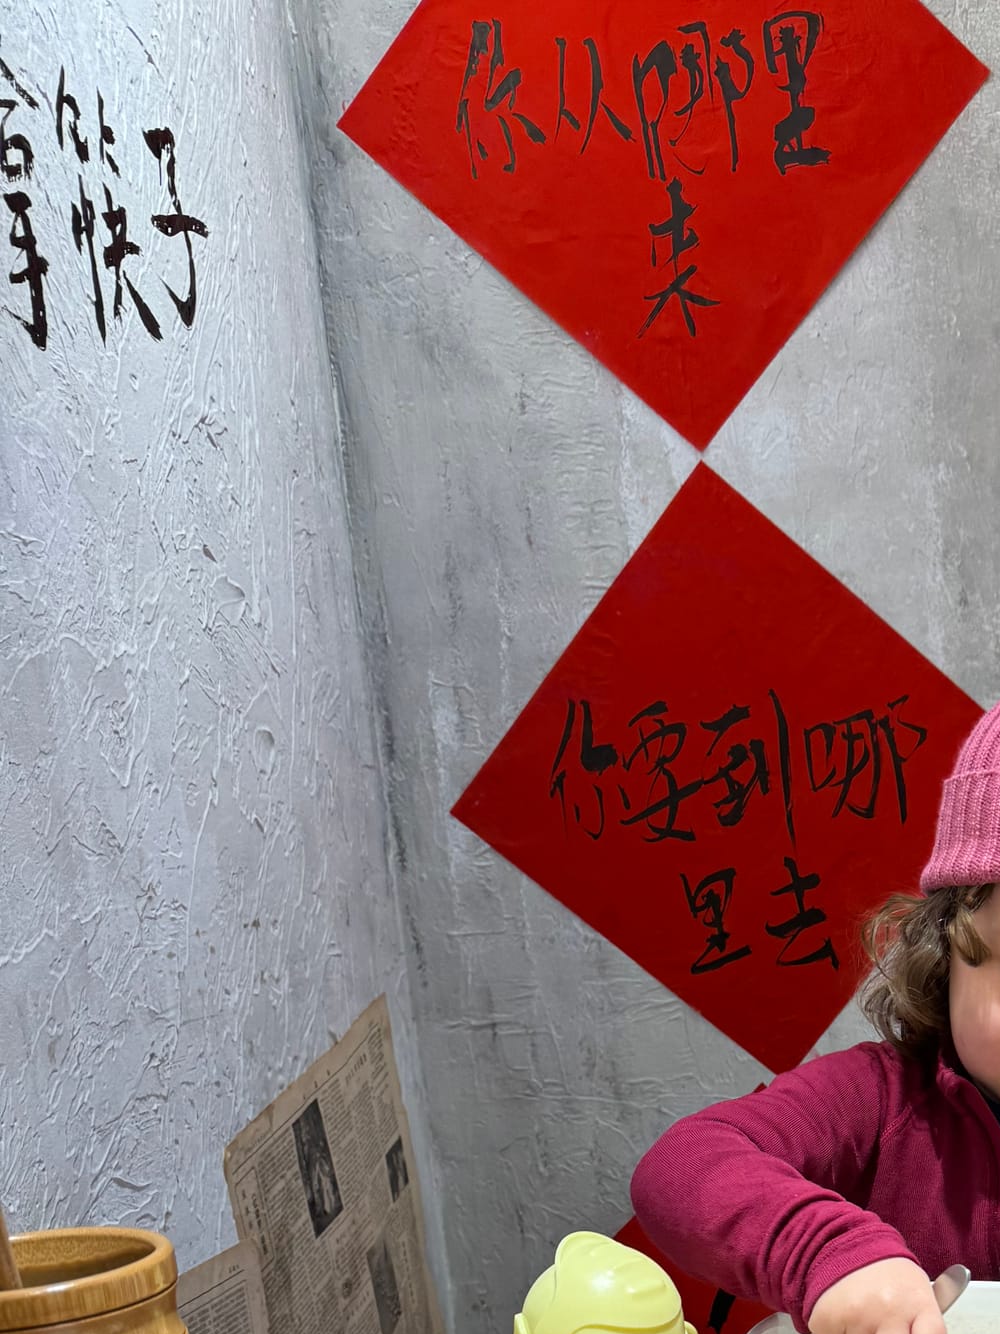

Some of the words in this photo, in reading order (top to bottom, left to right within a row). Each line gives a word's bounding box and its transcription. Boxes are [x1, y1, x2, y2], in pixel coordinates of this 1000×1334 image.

[457, 11, 830, 180] 你从哪里
[637, 177, 720, 339] 来
[550, 688, 928, 848] 你要到哪
[680, 857, 840, 975] 里去
